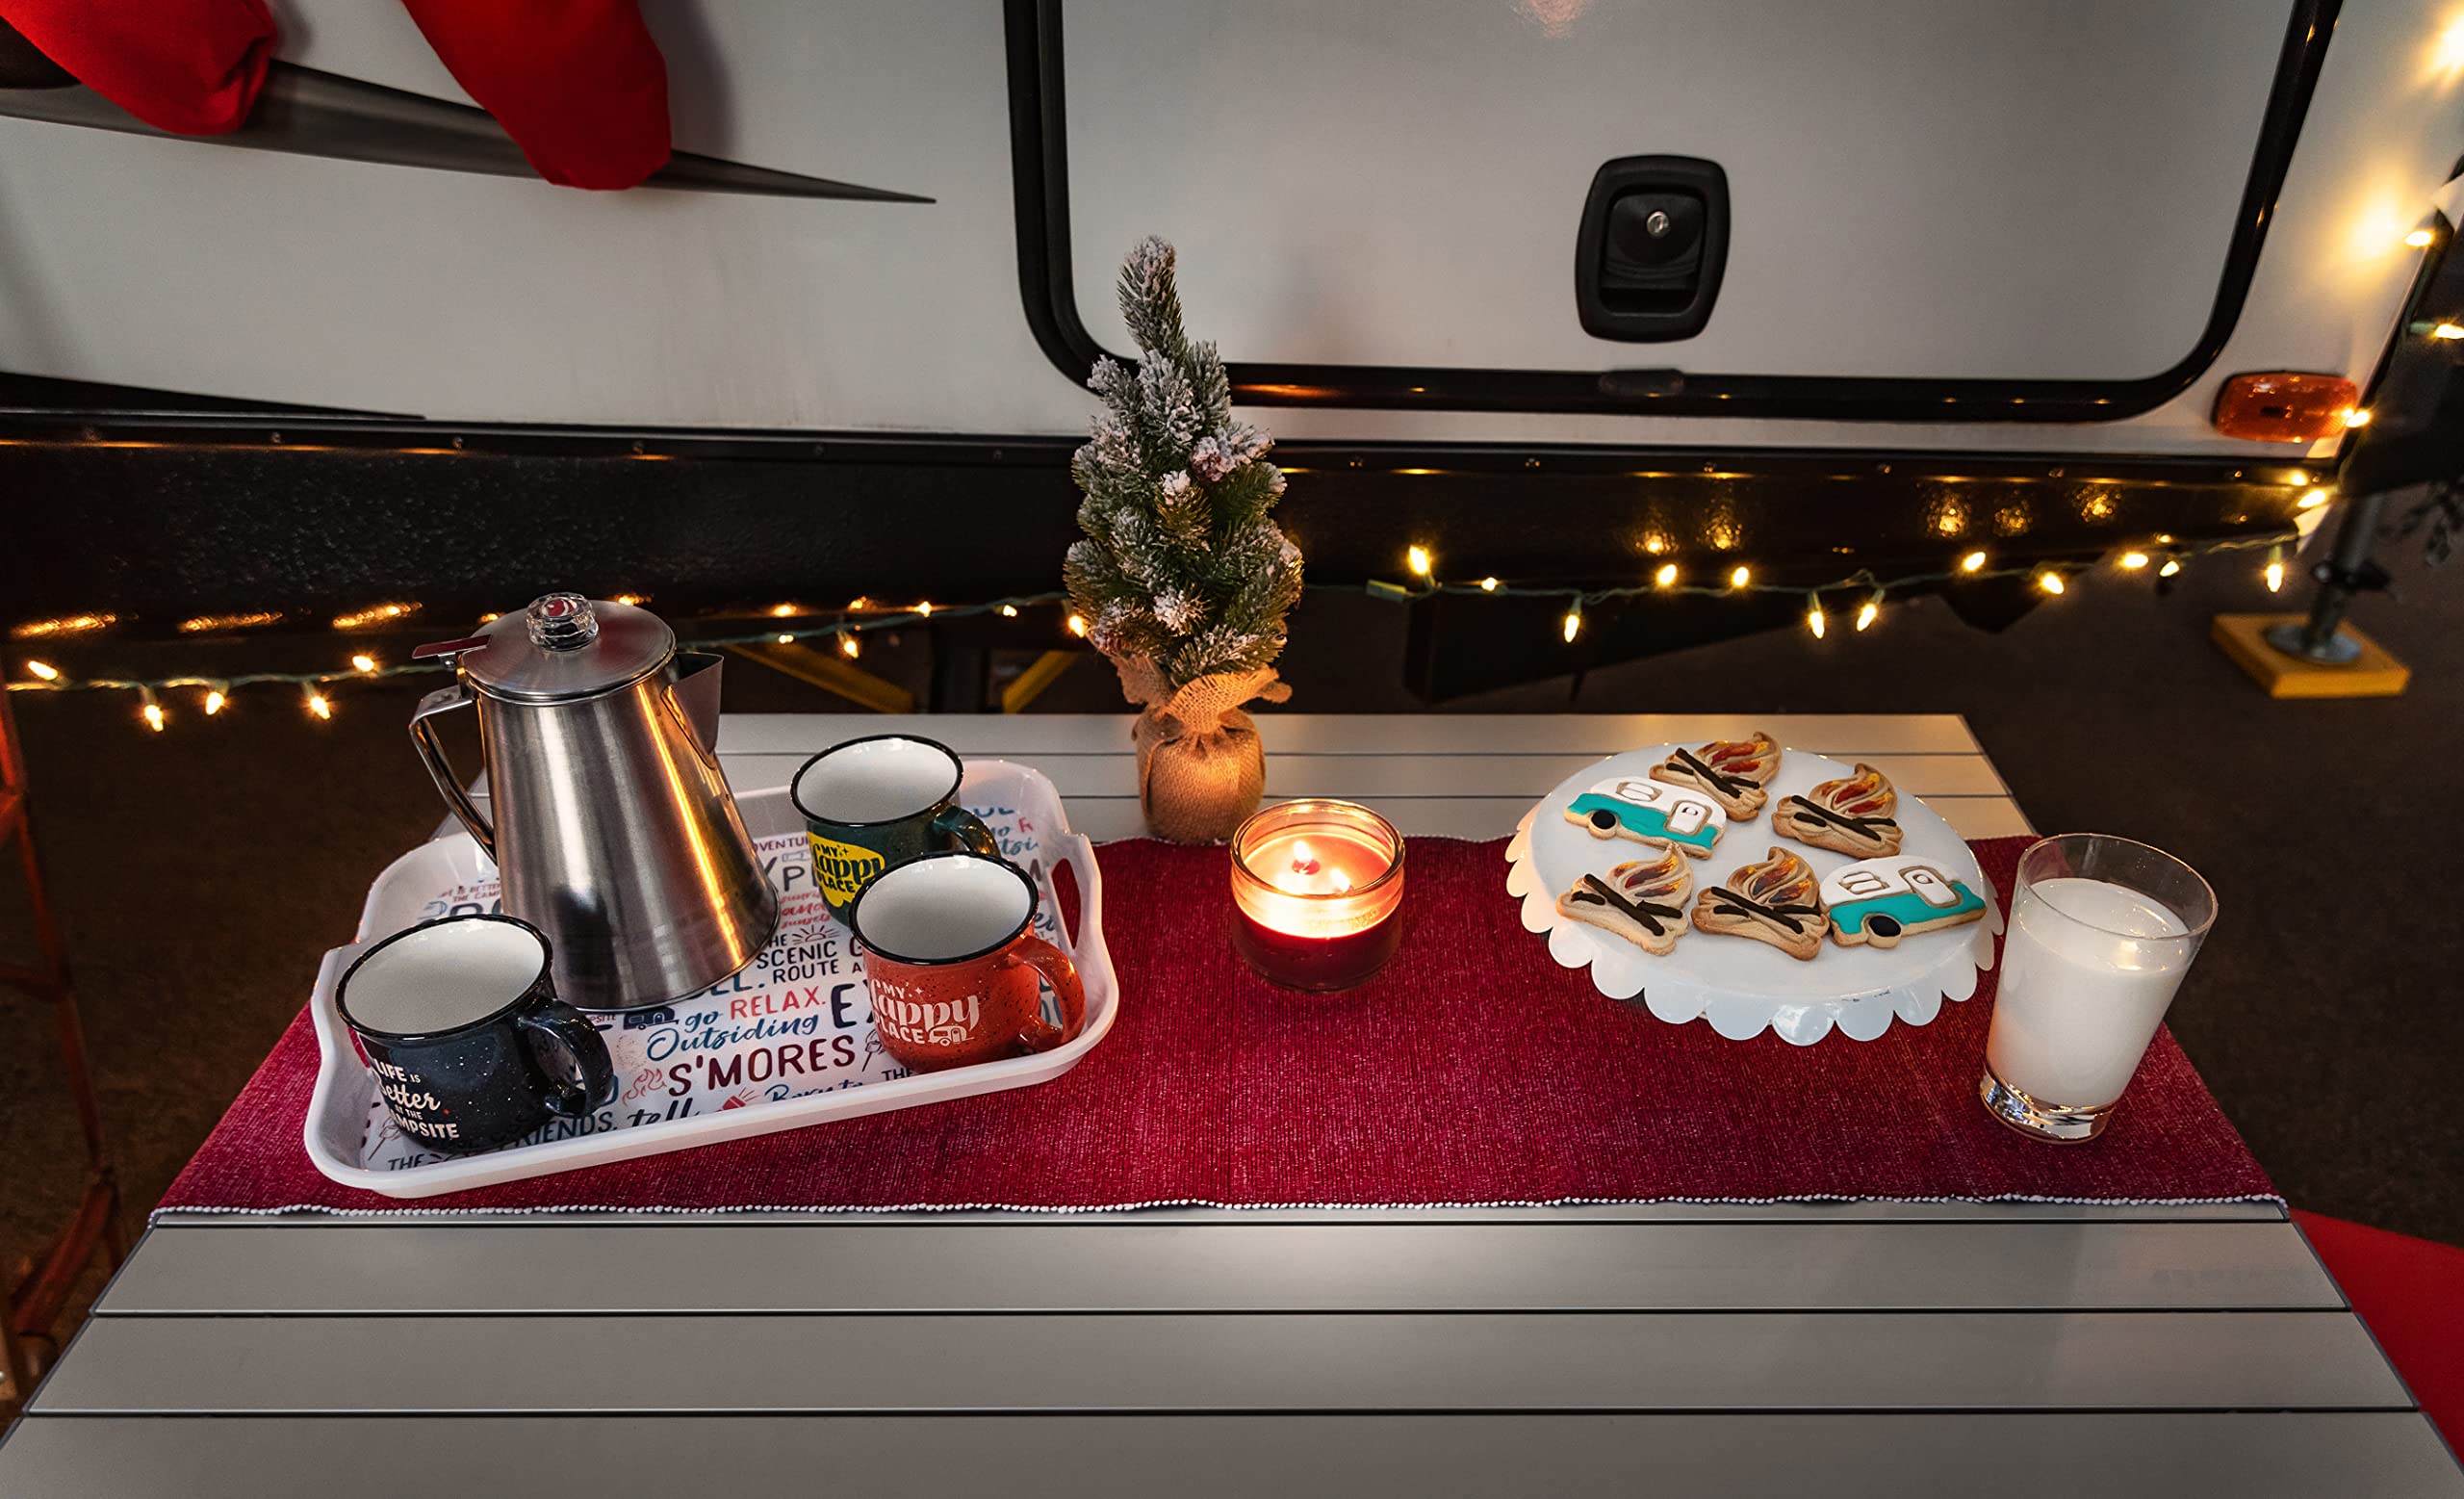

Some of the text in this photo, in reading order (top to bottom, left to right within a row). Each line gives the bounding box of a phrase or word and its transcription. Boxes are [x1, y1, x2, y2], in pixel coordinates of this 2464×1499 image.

[821, 844, 837, 858] MY
[769, 934, 787, 948] HE
[757, 940, 837, 969] SCENIC
[773, 959, 839, 984] ROUTE
[882, 981, 906, 999] MY
[684, 1011, 723, 1034] go
[730, 985, 827, 1021] RELAX.
[647, 1013, 819, 1062] Outsiding
[374, 1058, 421, 1083] LIFE IS
[668, 1034, 856, 1098] S'MORES
[405, 1108, 423, 1121] THE
